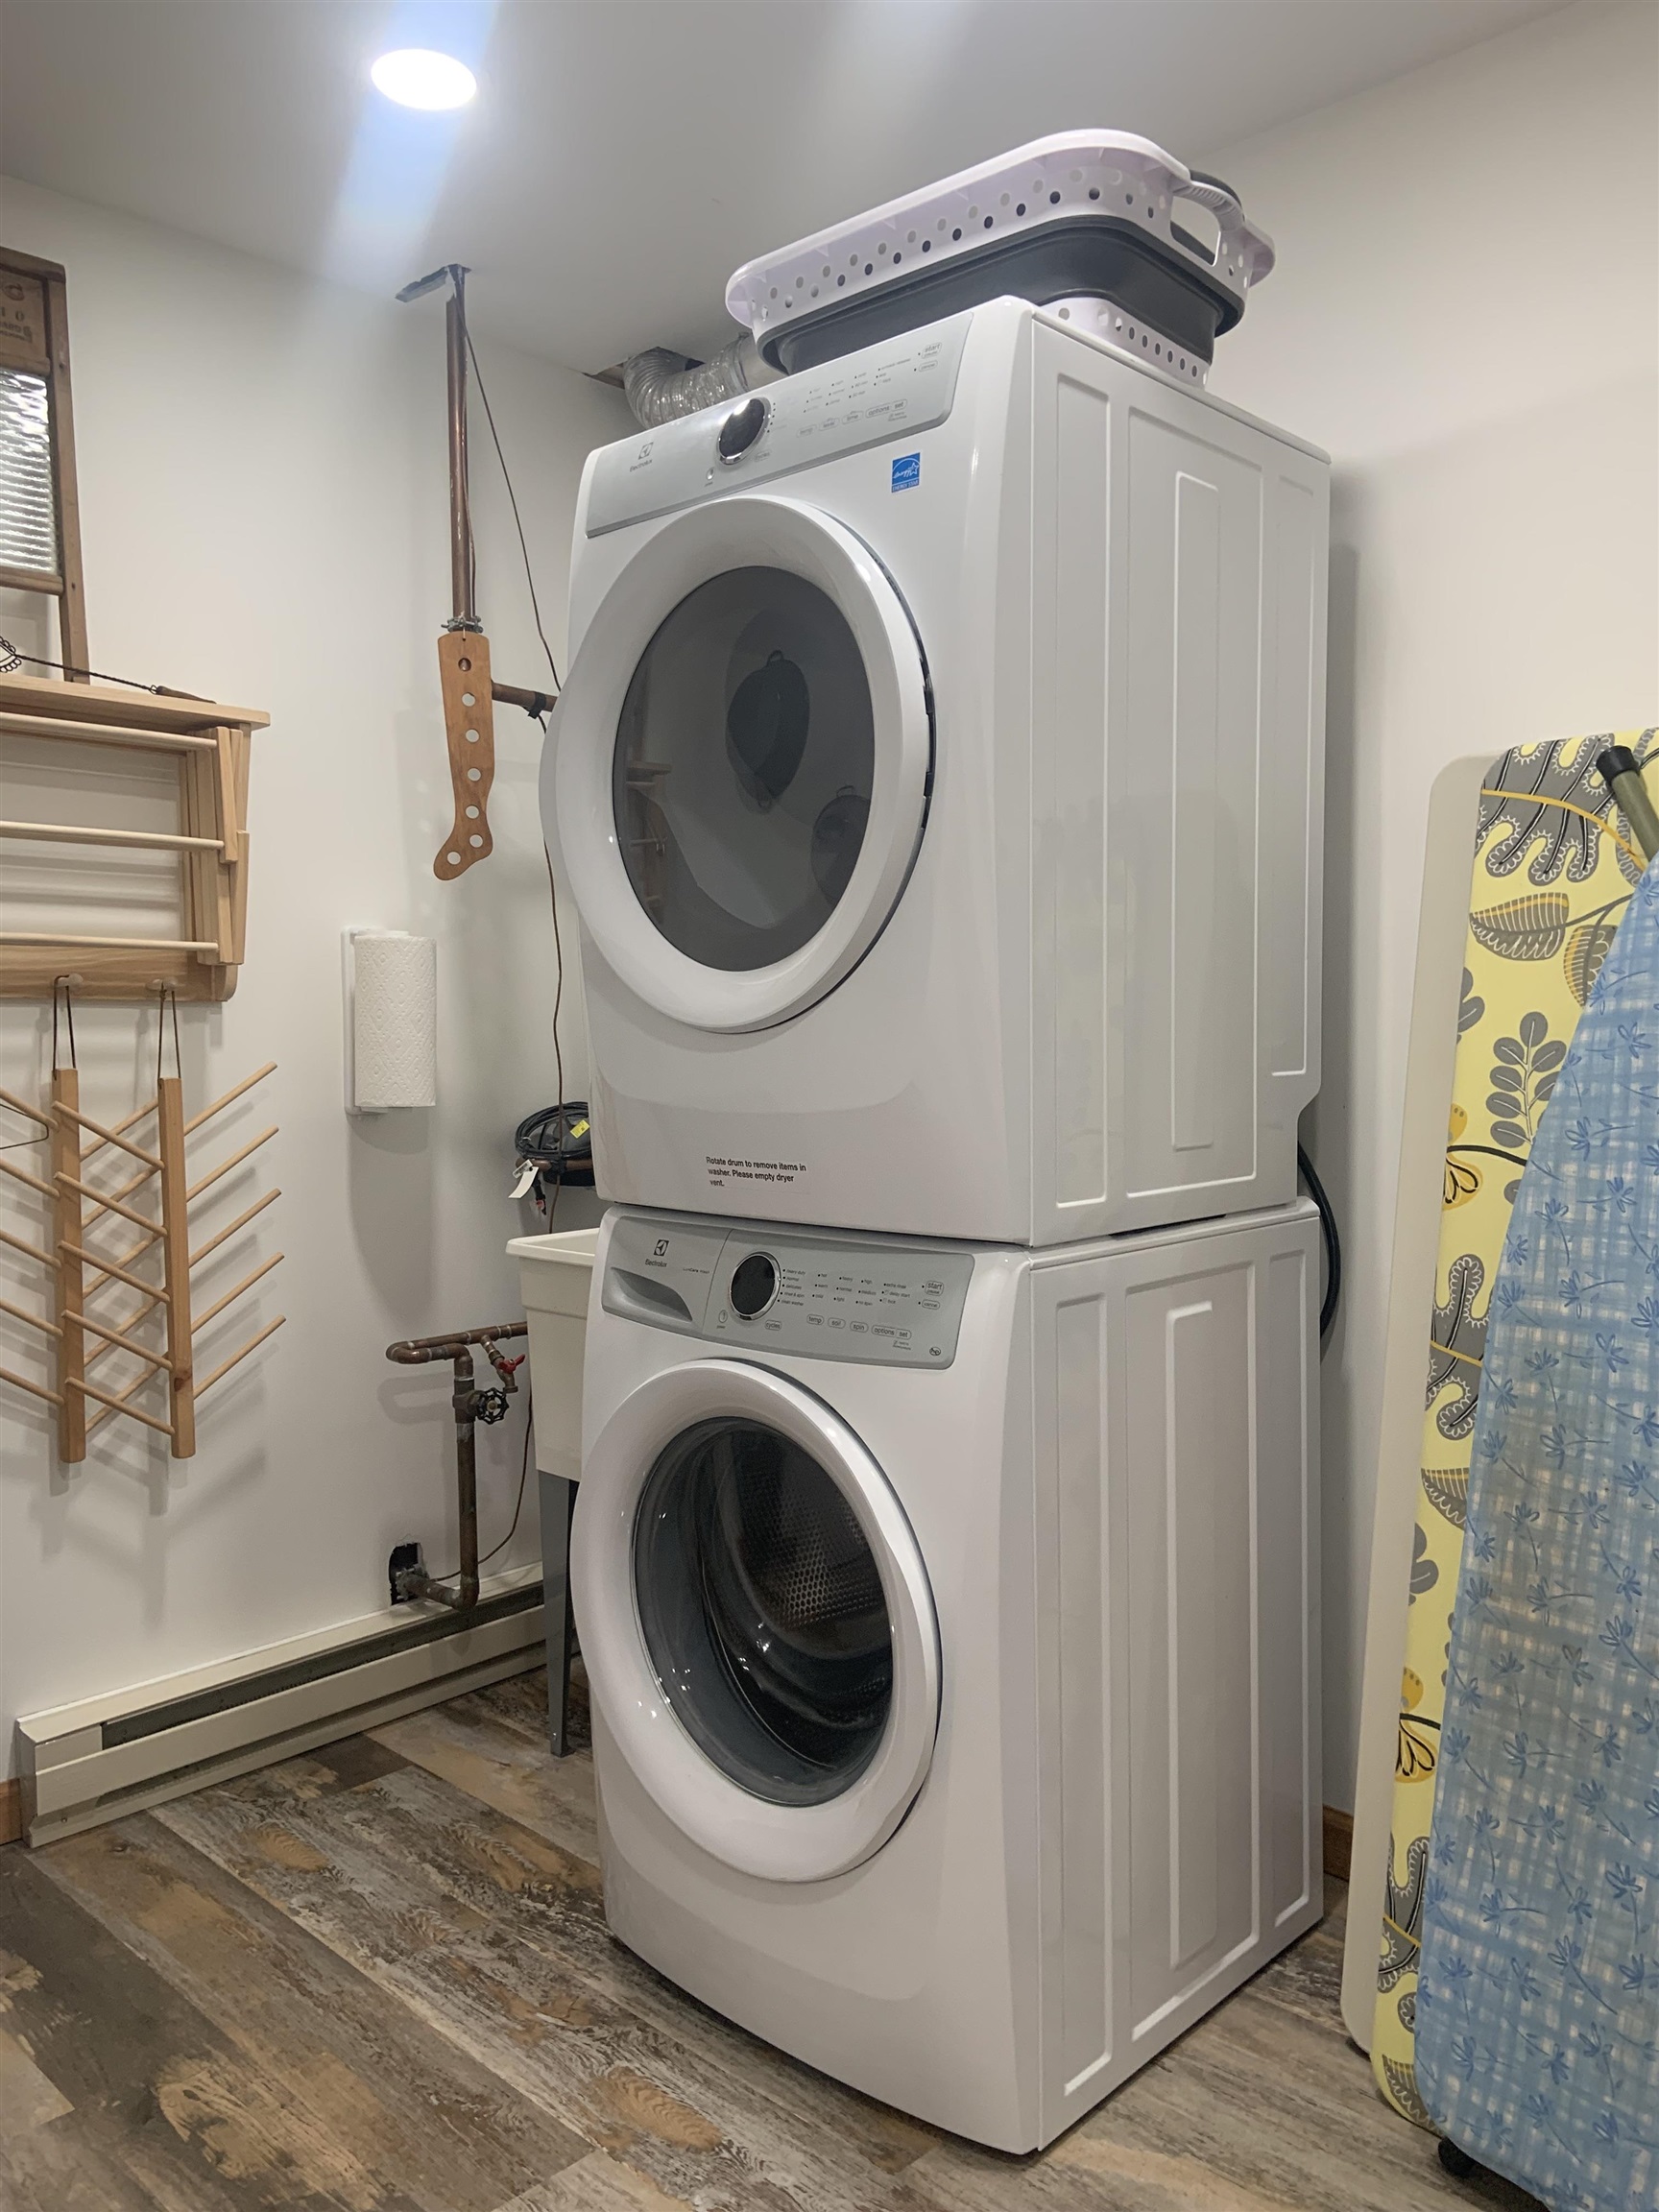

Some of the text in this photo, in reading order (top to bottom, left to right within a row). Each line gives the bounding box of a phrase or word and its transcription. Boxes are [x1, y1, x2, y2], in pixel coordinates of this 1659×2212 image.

[868, 406, 890, 416] options
[706, 1156, 726, 1166] Rotate
[728, 1158, 744, 1166] drum
[779, 1162, 798, 1171] items
[800, 1163, 806, 1171] in
[733, 1169, 754, 1179] Please
[755, 1172, 775, 1182] empty
[777, 1172, 794, 1183] dryer
[644, 1258, 667, 1267] Electrolux
[874, 1327, 895, 1335] options
